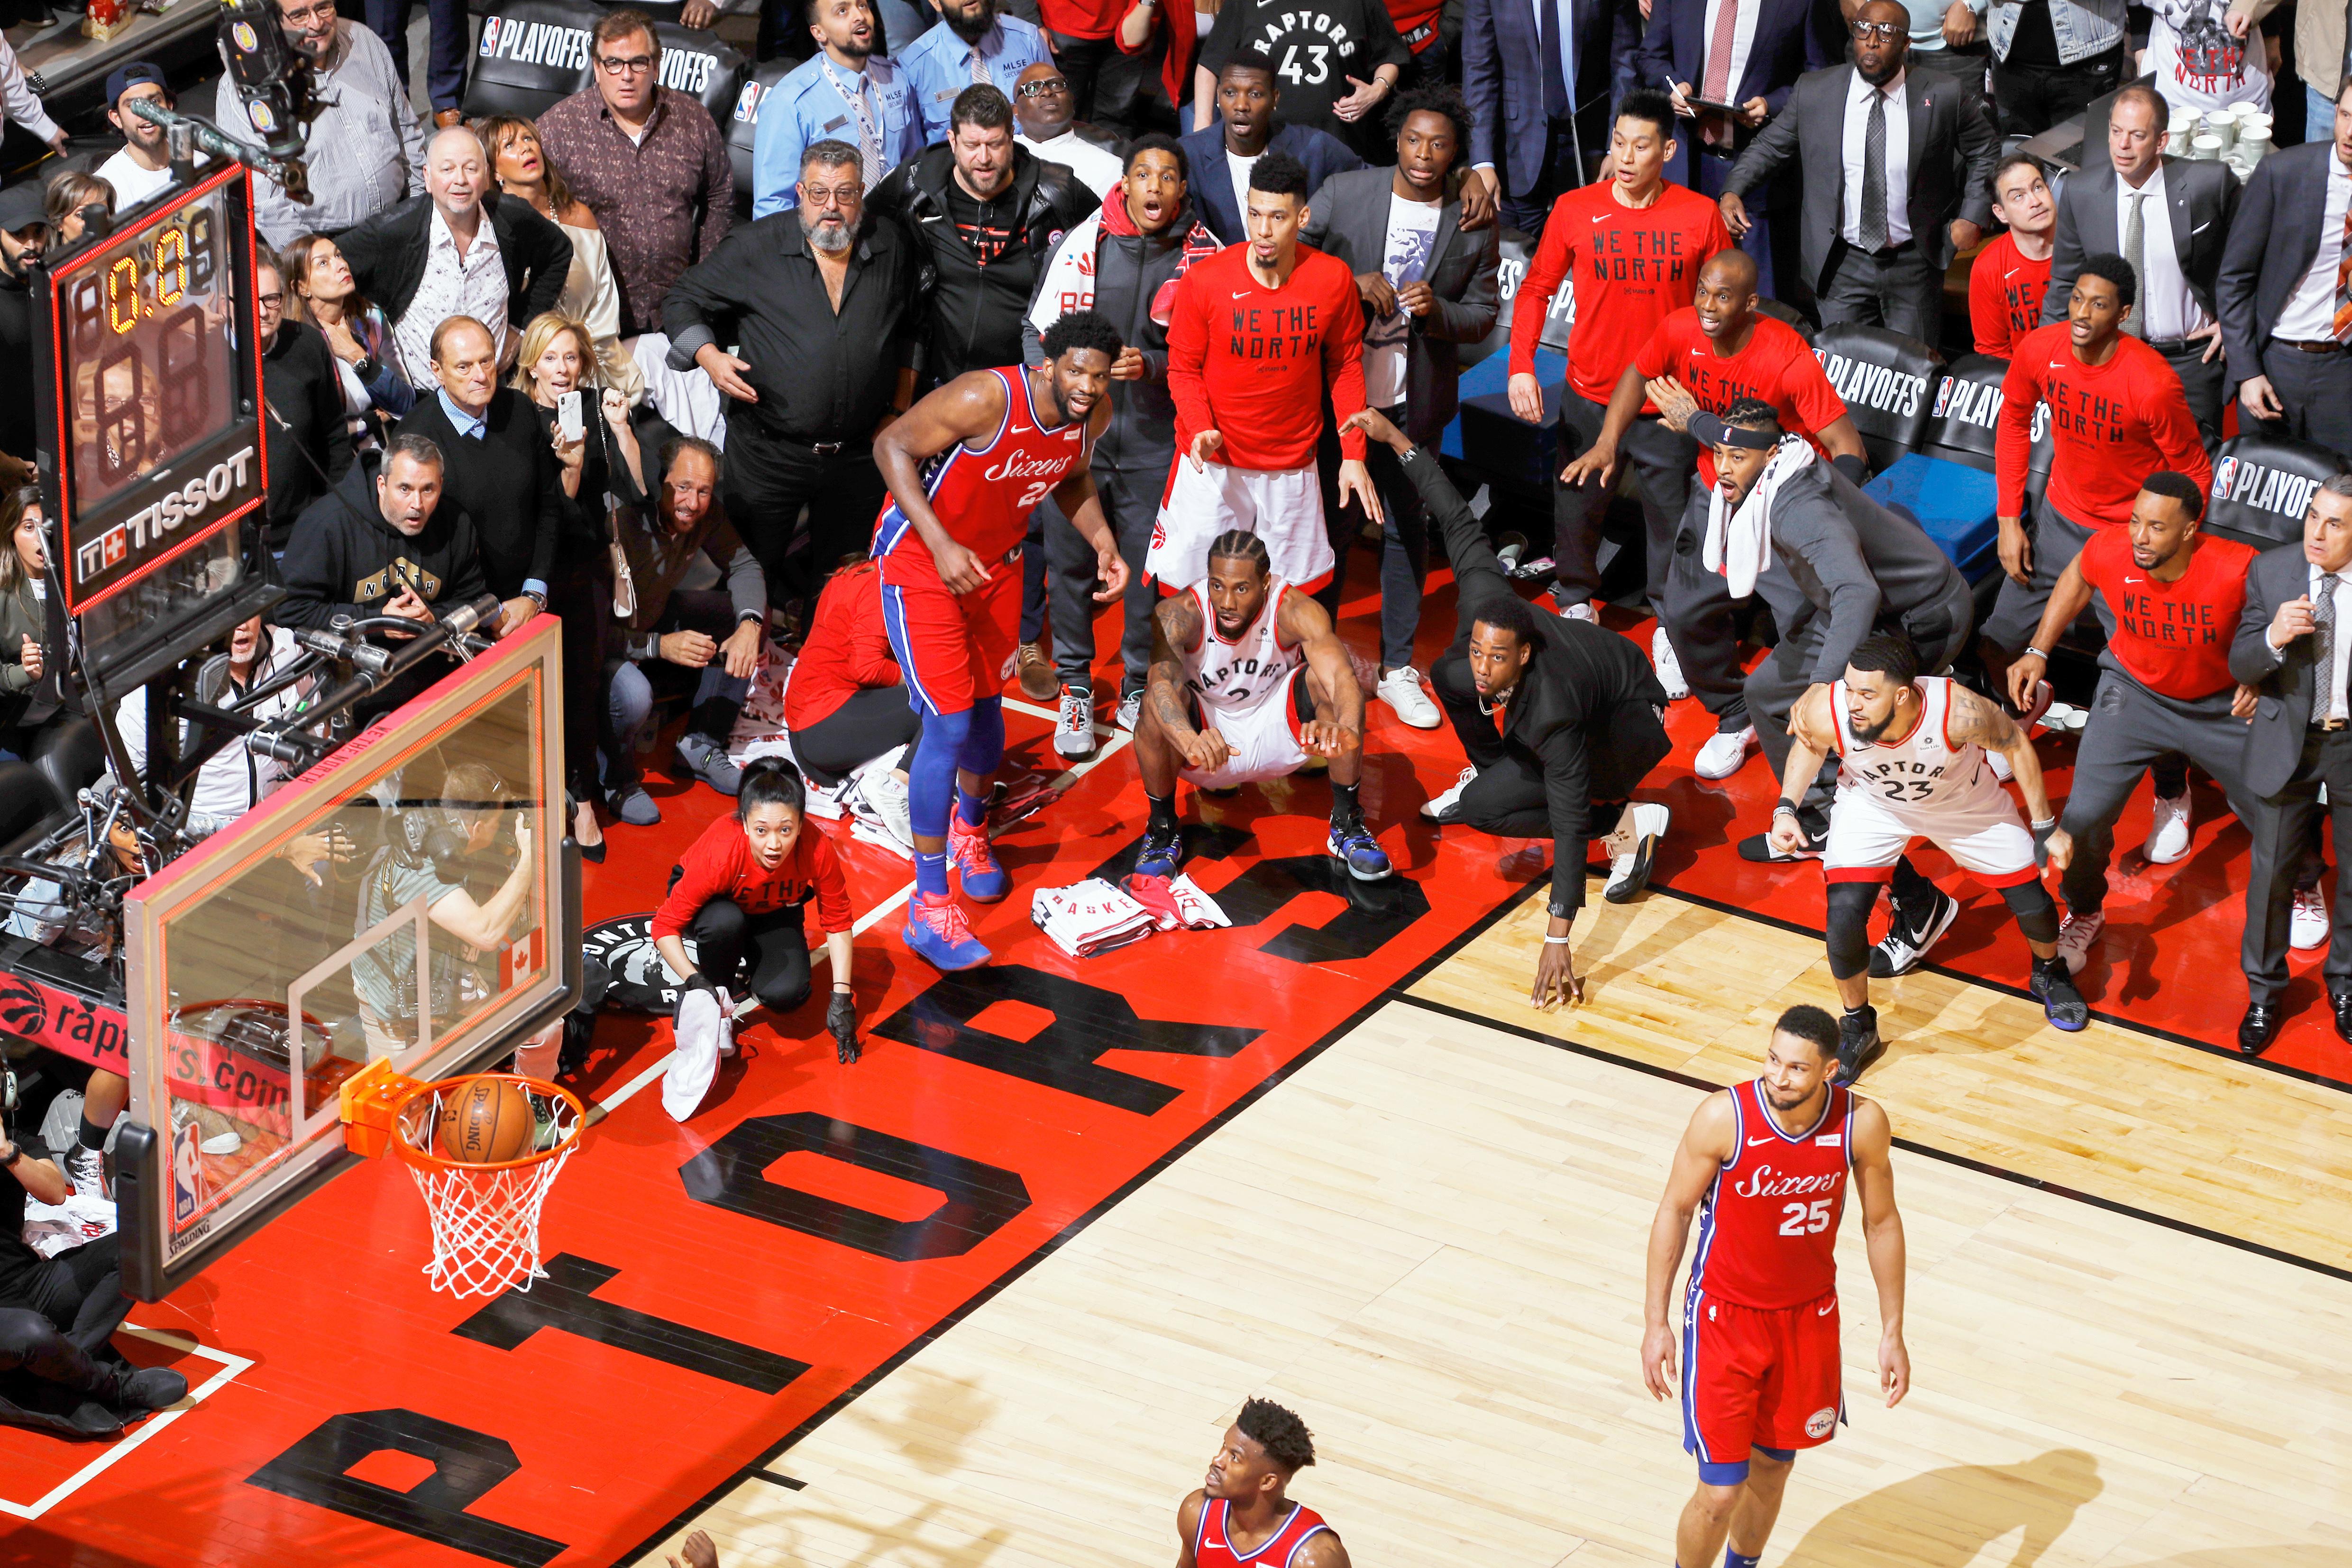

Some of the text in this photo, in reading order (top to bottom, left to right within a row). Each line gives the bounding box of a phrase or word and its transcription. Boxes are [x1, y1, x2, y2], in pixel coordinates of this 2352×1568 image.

[495, 19, 594, 70] PLAYOFFS
[1254, 11, 1355, 56] RAPTORS
[655, 47, 718, 92] YOFFS
[1003, 59, 1027, 71] MLSE
[1278, 45, 1328, 85] 43
[2175, 62, 2246, 94] NORTH
[842, 89, 851, 100] MLSE
[886, 90, 902, 101] MLSE
[1593, 230, 1682, 256] WE THE
[1594, 258, 1683, 282] NORTH
[2005, 283, 2034, 308] WE
[1234, 305, 1318, 333] WE THE
[1231, 333, 1318, 359] NORTH
[1689, 362, 1710, 393] WE
[1825, 354, 1927, 417] PLAYOFFS
[2047, 375, 2123, 425] WE THE
[984, 449, 1072, 481] Sixers
[127, 446, 254, 549] TISSOT
[2231, 461, 2324, 520] PLAYOF
[2123, 591, 2214, 625] WE THE
[2123, 615, 2216, 645] NORTH
[1185, 658, 1281, 693] RAPTORS
[299, 725, 392, 784] WE THE NORTH
[1862, 761, 1946, 780] APTOR
[1880, 780, 1934, 802] 23
[466, 1086, 490, 1152] SPALDING
[1734, 1165, 1841, 1198] Sixers
[1779, 1198, 1833, 1236] 25
[169, 1219, 210, 1258] SPALDING
